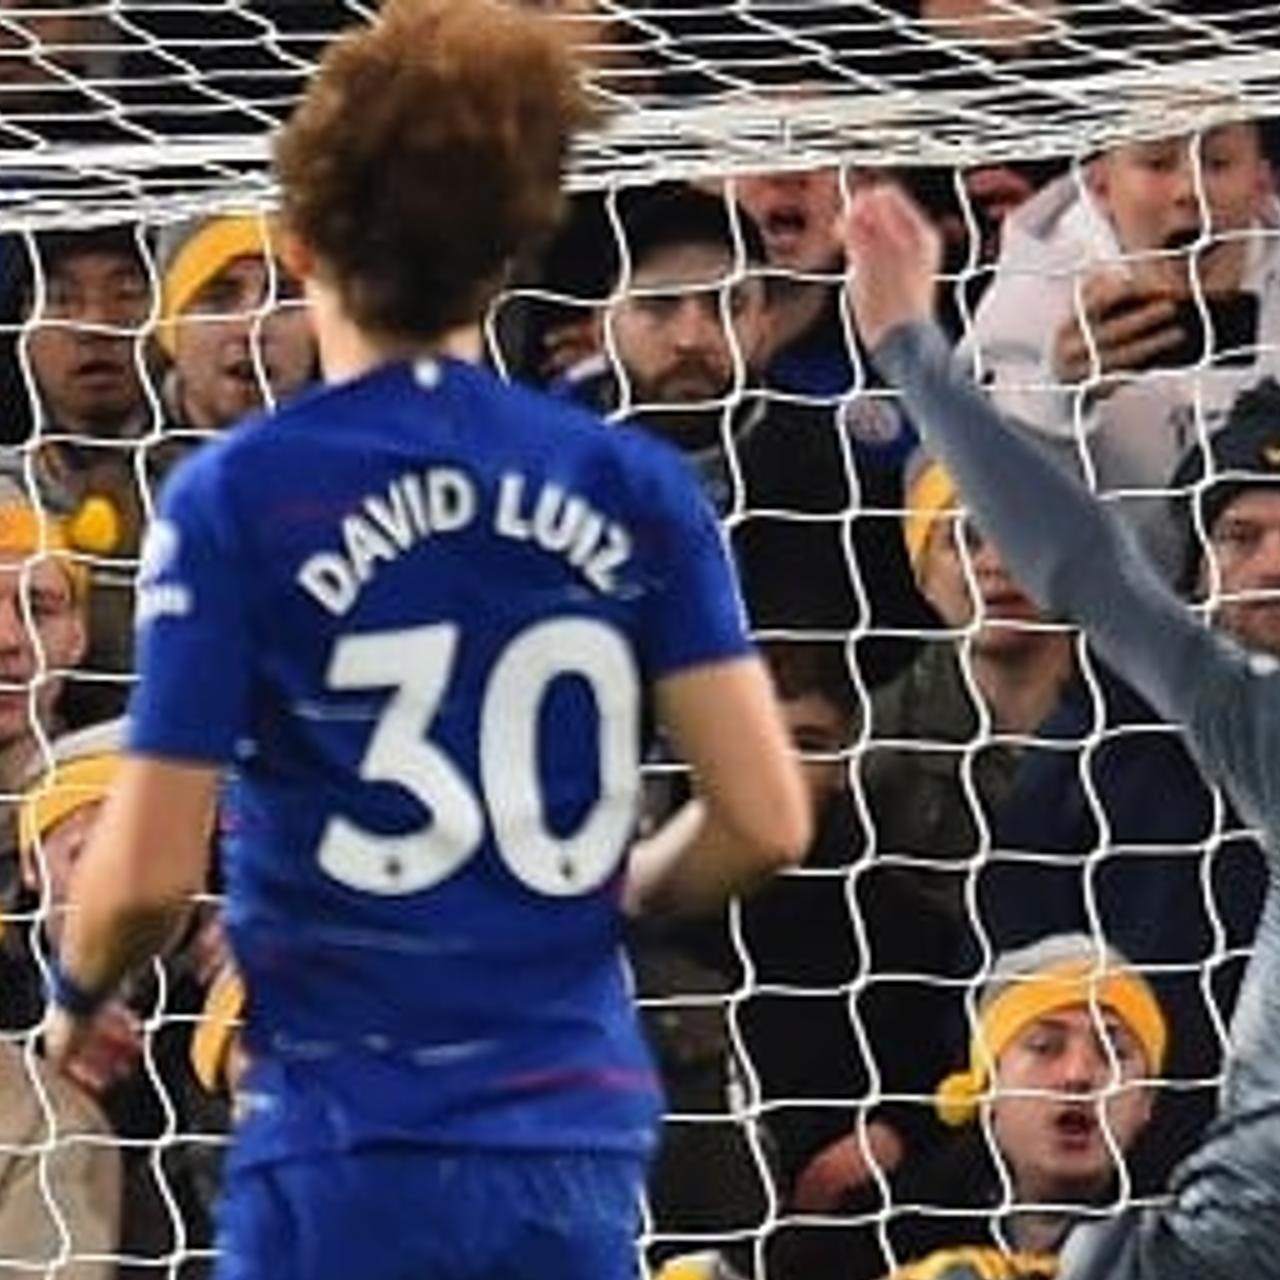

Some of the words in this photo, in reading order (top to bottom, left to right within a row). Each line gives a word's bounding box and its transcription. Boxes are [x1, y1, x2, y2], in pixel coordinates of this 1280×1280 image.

[297, 467, 476, 617] DAVID
[494, 472, 632, 593] LUIZ
[315, 618, 642, 897] 30
